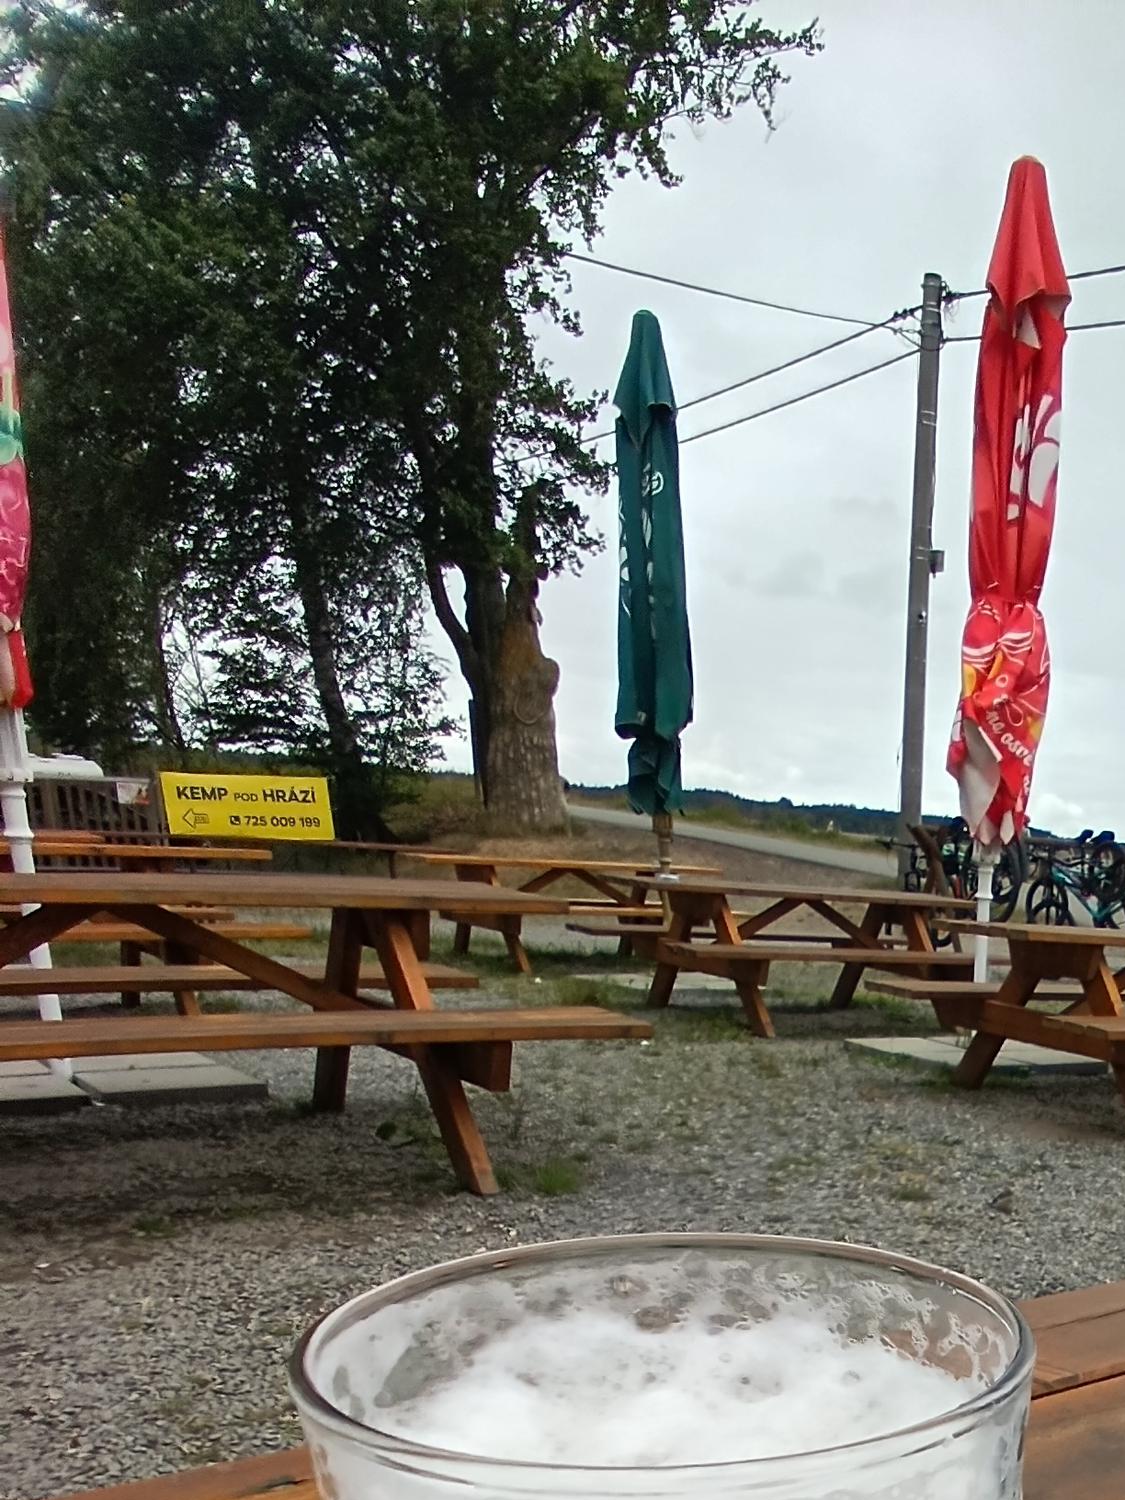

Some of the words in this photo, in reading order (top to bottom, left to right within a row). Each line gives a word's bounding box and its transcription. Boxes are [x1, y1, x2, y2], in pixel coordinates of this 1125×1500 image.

[176, 785, 228, 801] KEMP
[234, 792, 258, 802] POD
[263, 786, 316, 803] HRÁZÍ
[245, 816, 267, 826] 725
